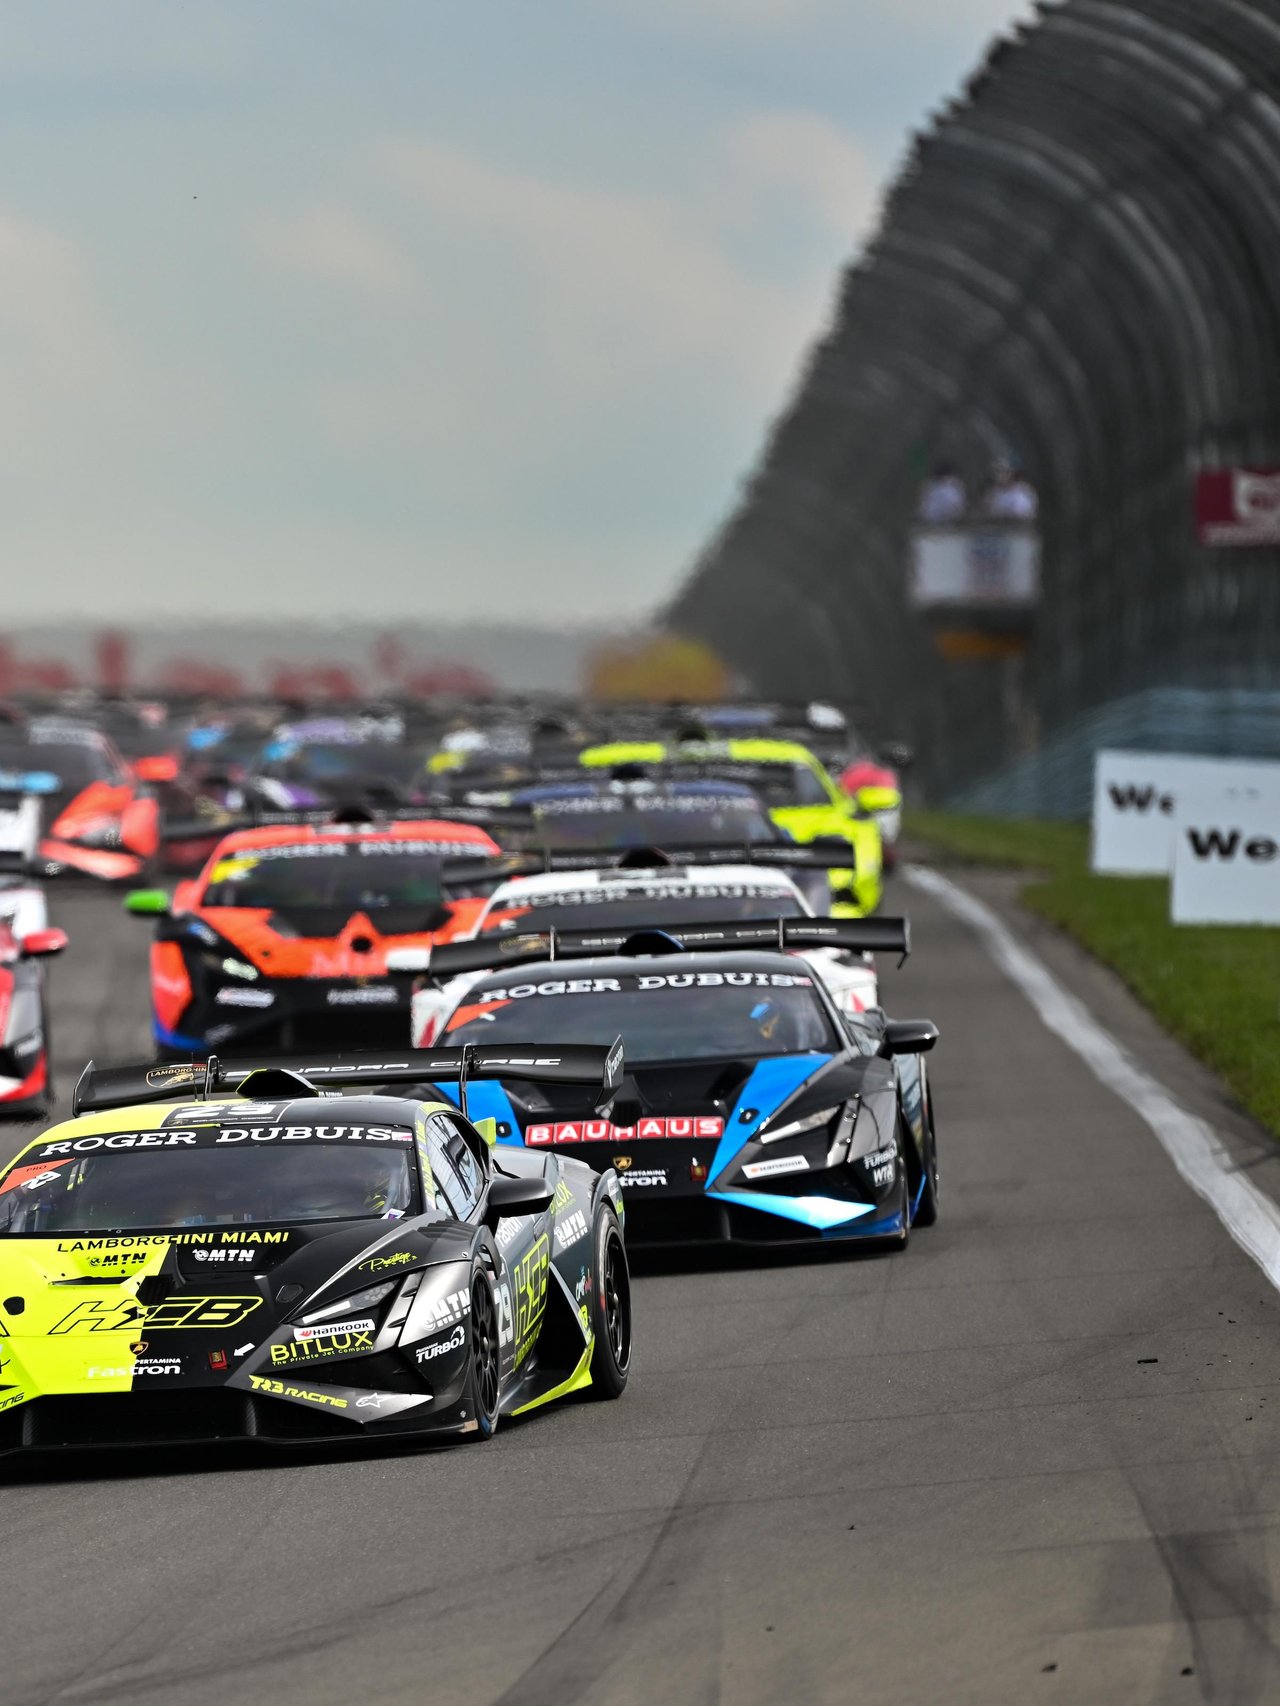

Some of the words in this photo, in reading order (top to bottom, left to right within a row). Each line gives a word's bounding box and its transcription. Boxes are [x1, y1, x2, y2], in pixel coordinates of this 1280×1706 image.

[479, 977, 621, 1002] ROGER
[638, 972, 793, 990] DUBUIS
[39, 1131, 197, 1156] ROGER
[216, 1126, 393, 1143] DUBUIS
[21, 1171, 62, 1190] 29
[57, 1232, 213, 1252] LAMBORGHINI
[221, 1231, 289, 1244] MIAMI
[101, 1252, 147, 1267] MTN
[207, 1249, 255, 1262] MTN
[270, 1331, 373, 1362] BITLUX
[290, 1353, 319, 1362] Private
[338, 1344, 375, 1354] Company
[416, 1337, 460, 1364] TURBO
[86, 1364, 181, 1378] Fastron
[285, 1387, 348, 1409] RACING
